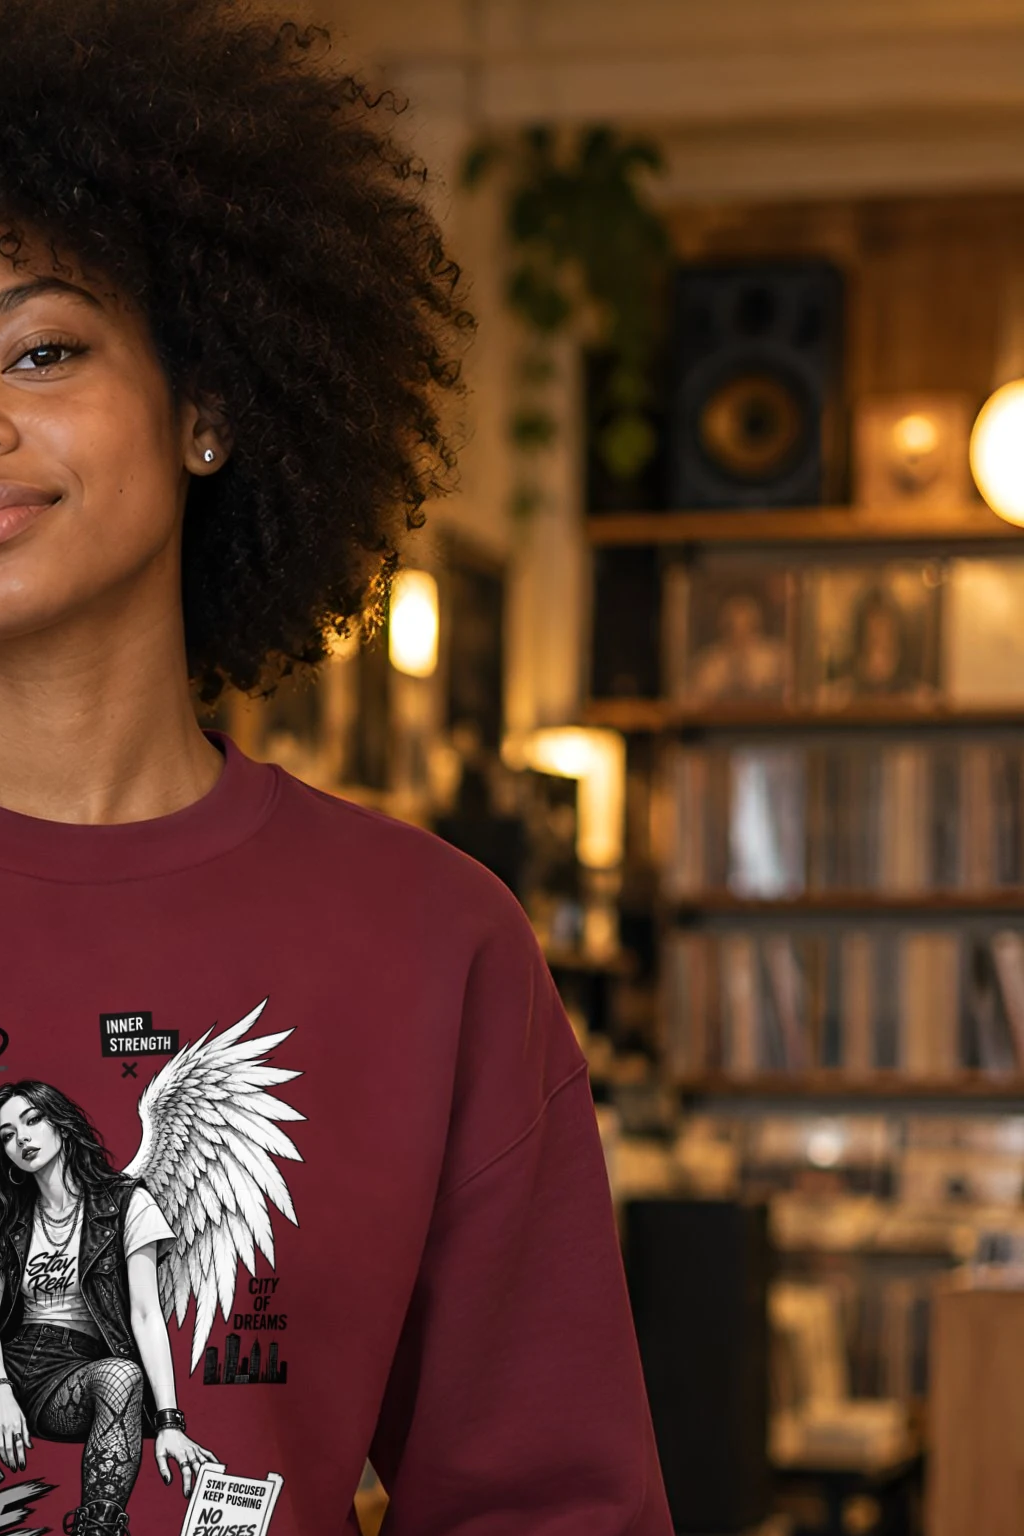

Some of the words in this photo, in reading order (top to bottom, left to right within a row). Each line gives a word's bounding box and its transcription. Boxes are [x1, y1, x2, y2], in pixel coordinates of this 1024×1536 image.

[106, 1017, 143, 1034] INNER
[110, 1036, 171, 1052] STRENGTH
[26, 1250, 77, 1276] Stay
[248, 1277, 280, 1294] CITY
[253, 1296, 271, 1311] OF
[233, 1314, 288, 1330] DREAMS
[206, 1479, 227, 1490] STAY
[228, 1482, 266, 1497] FOCUSED
[203, 1490, 224, 1503] KEEP
[226, 1495, 262, 1509] PUSHING
[197, 1507, 223, 1525] NO
